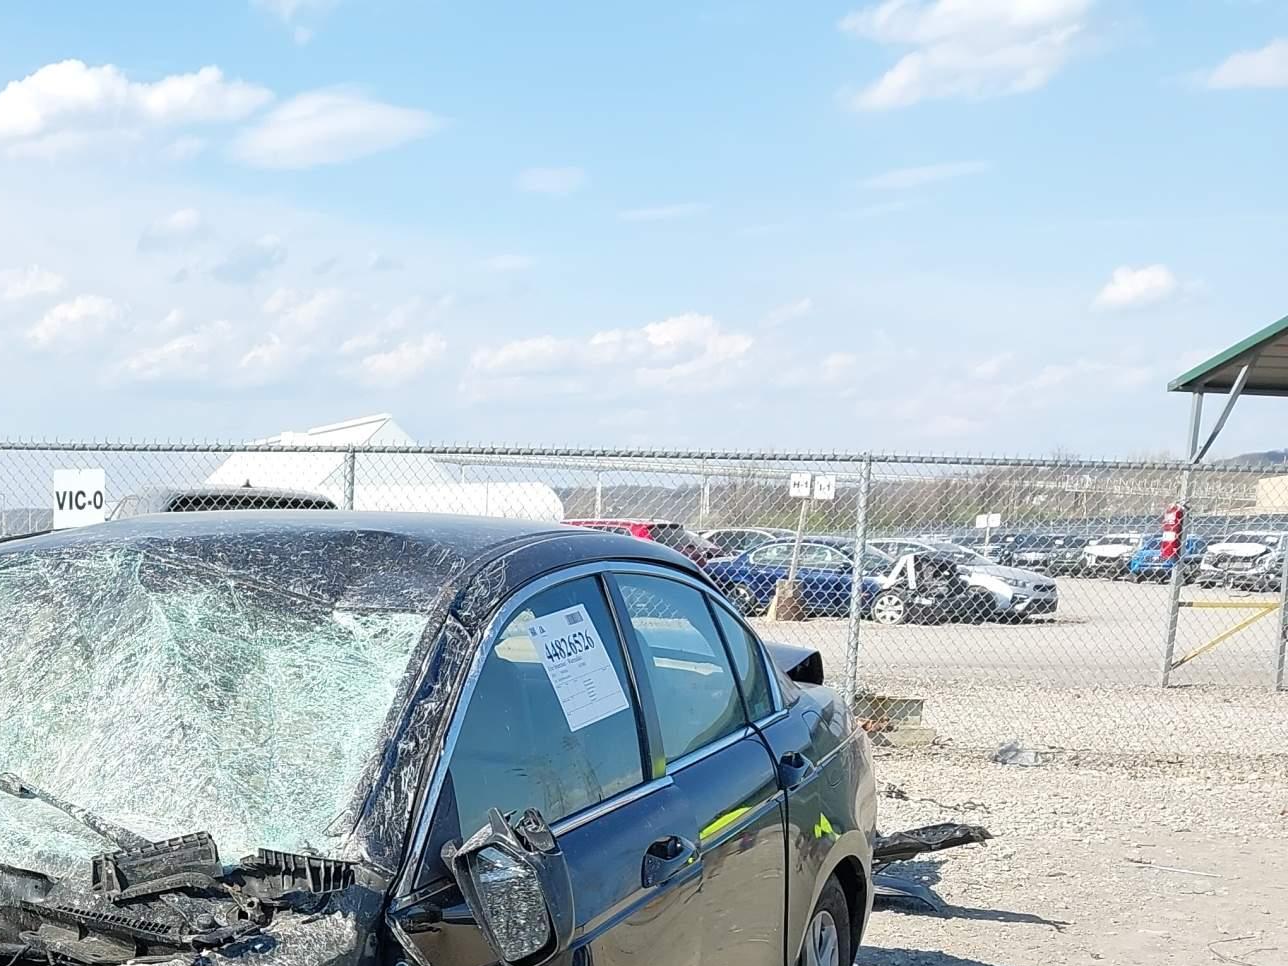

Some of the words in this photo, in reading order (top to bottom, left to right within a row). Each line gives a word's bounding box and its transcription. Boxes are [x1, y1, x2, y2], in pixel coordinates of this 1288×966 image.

[793, 480, 809, 488] H-1
[55, 490, 103, 510] VIC-0
[544, 629, 595, 662] 44826526
